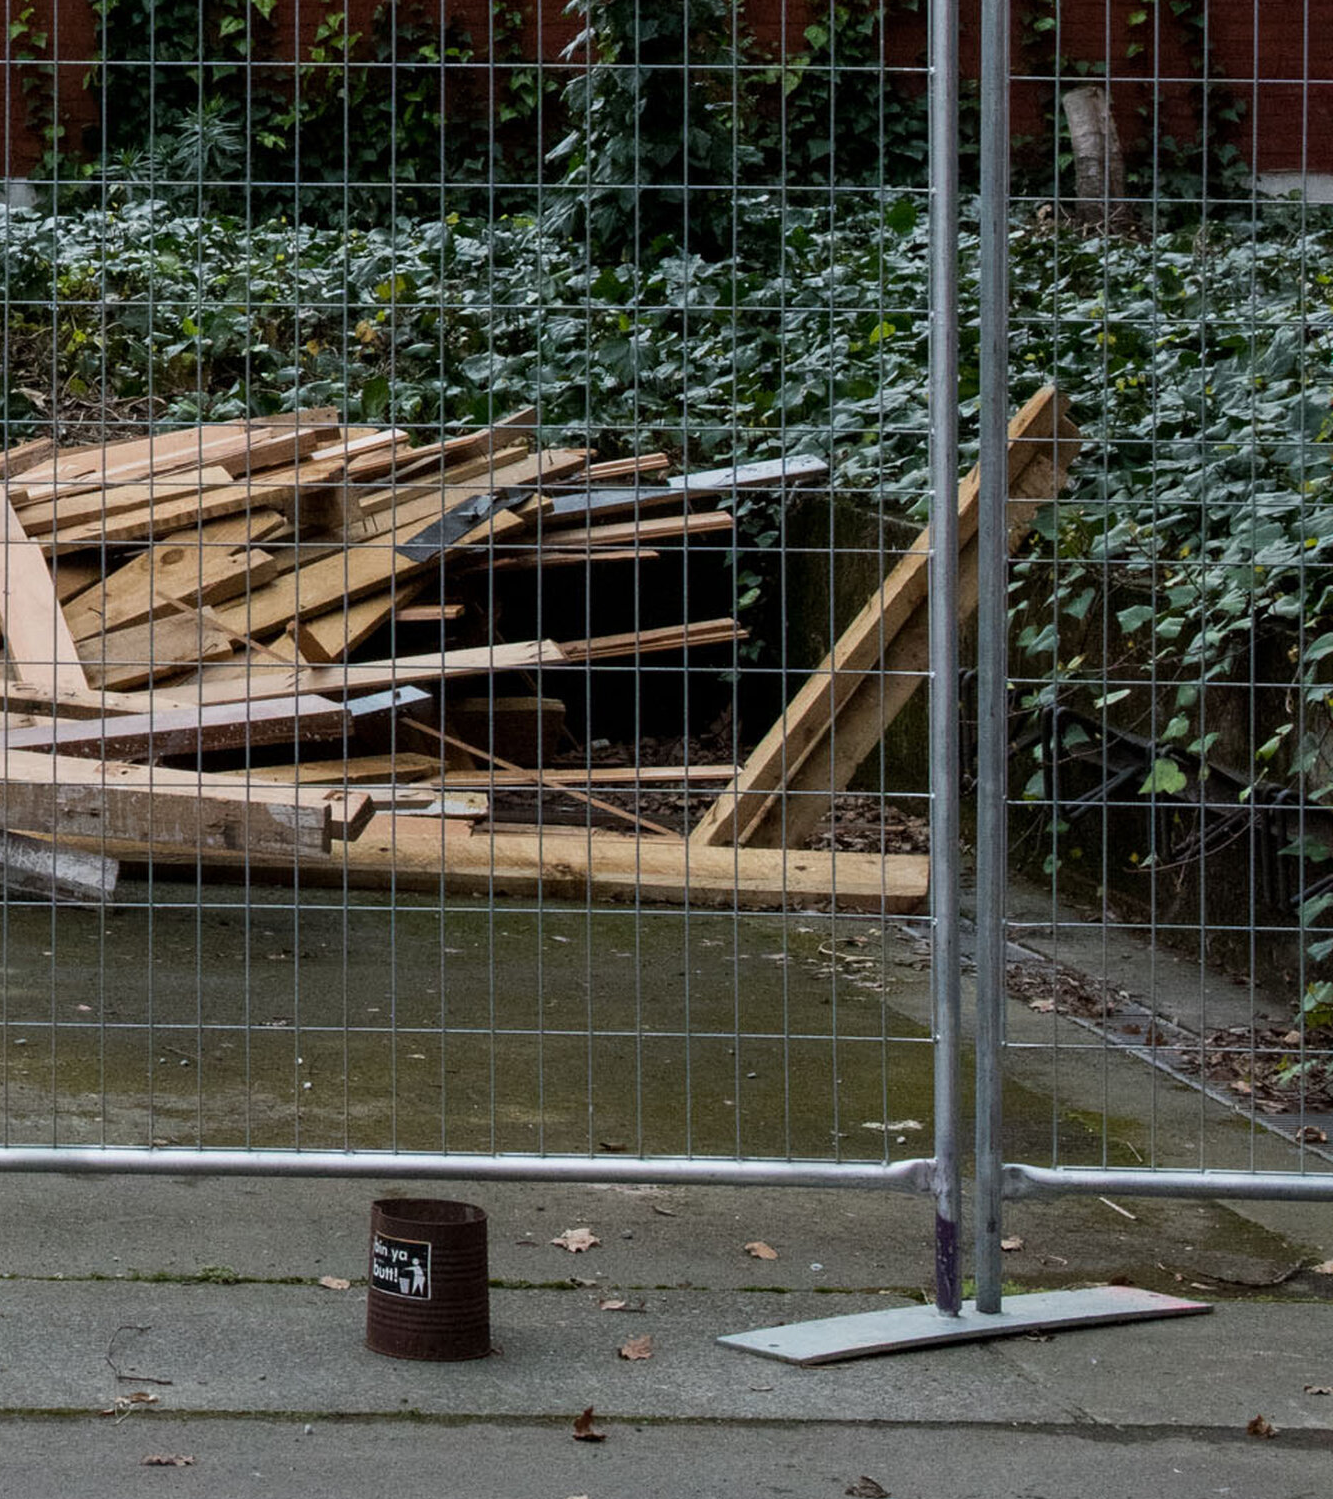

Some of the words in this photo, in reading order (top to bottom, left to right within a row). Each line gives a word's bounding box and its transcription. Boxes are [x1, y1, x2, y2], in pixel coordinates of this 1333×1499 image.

[374, 1235, 388, 1257] bin
[391, 1247, 408, 1263] ya
[373, 1257, 398, 1283] butt!
